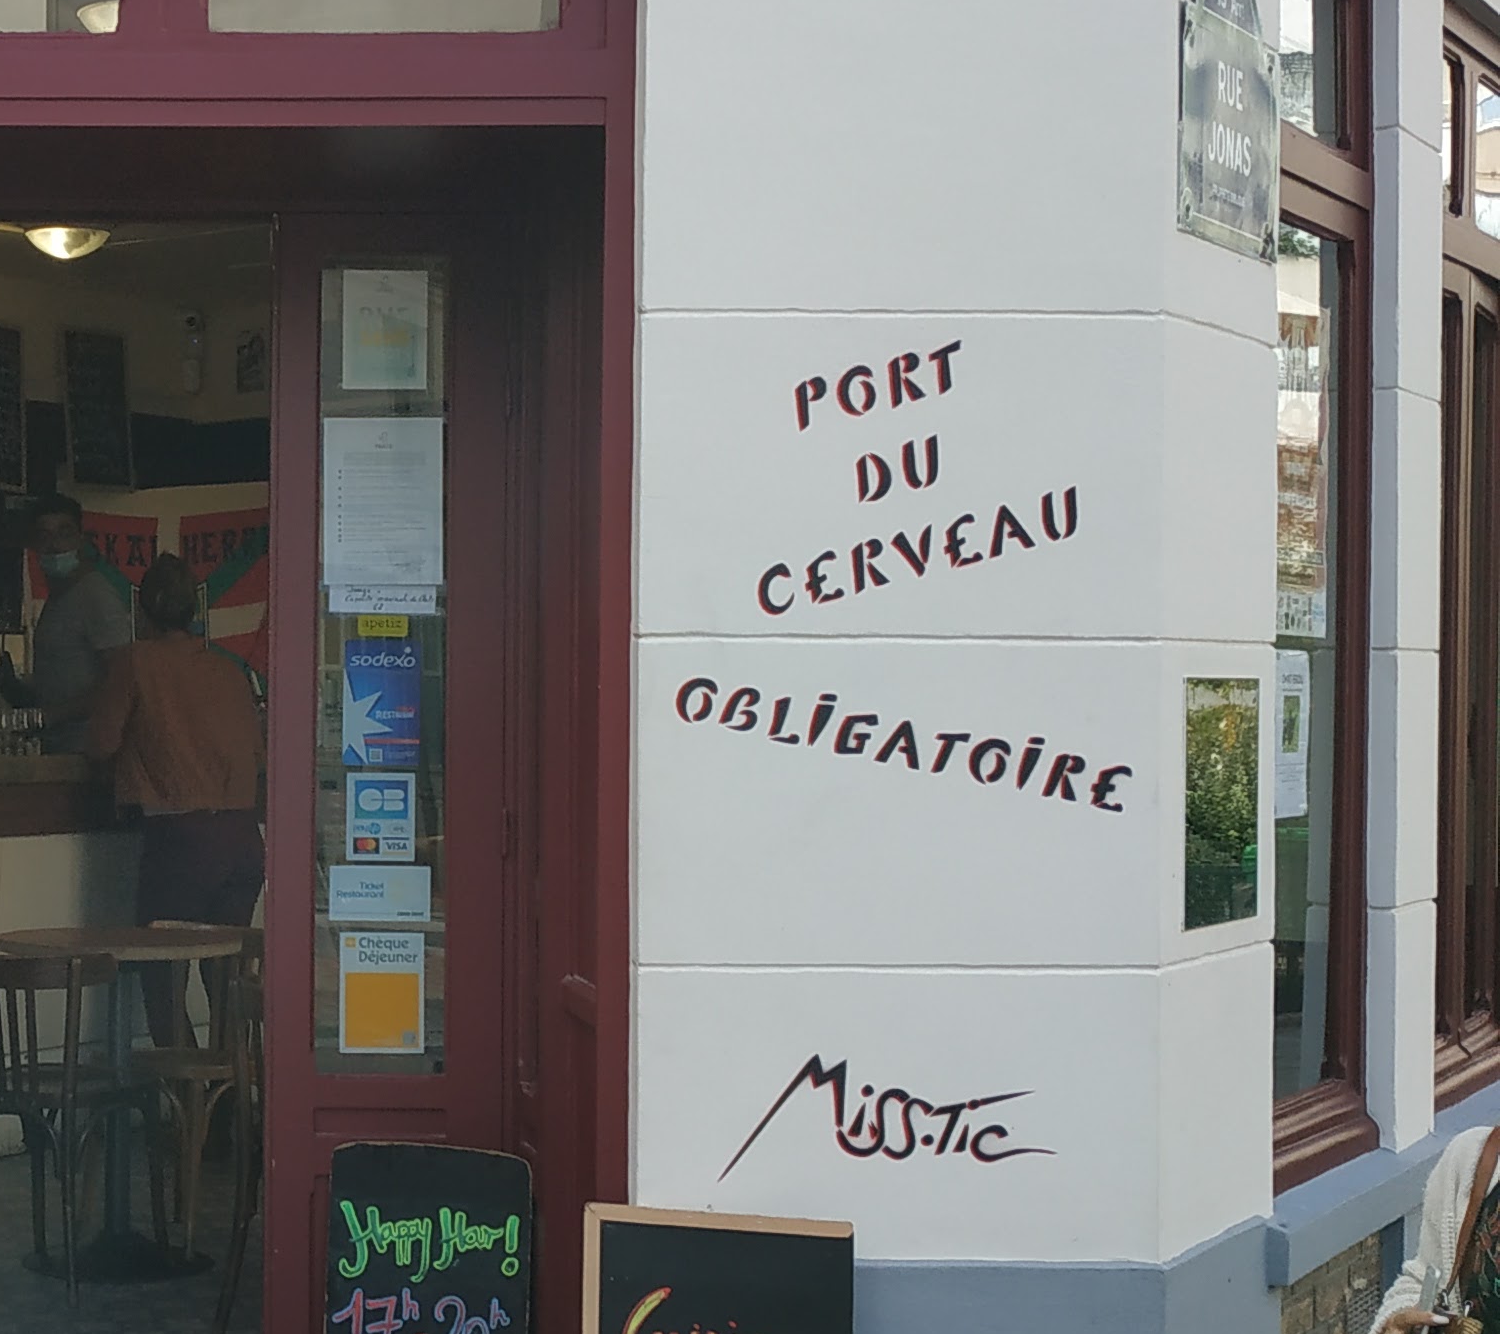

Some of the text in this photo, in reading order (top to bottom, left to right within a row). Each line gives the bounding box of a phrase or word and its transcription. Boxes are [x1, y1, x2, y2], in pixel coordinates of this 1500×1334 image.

[1217, 60, 1244, 112] RUE
[1207, 121, 1252, 178] JONAS
[792, 338, 964, 433] PORT
[854, 433, 940, 504] DU
[755, 484, 1079, 617] CERVEAU
[350, 648, 417, 668] sodexo
[385, 841, 408, 851] VISA
[336, 889, 384, 899] Restaurant
[359, 881, 385, 890] Ticket
[358, 936, 410, 951] Chèque
[358, 950, 418, 965] Déjeuner
[338, 1199, 432, 1283] Happy
